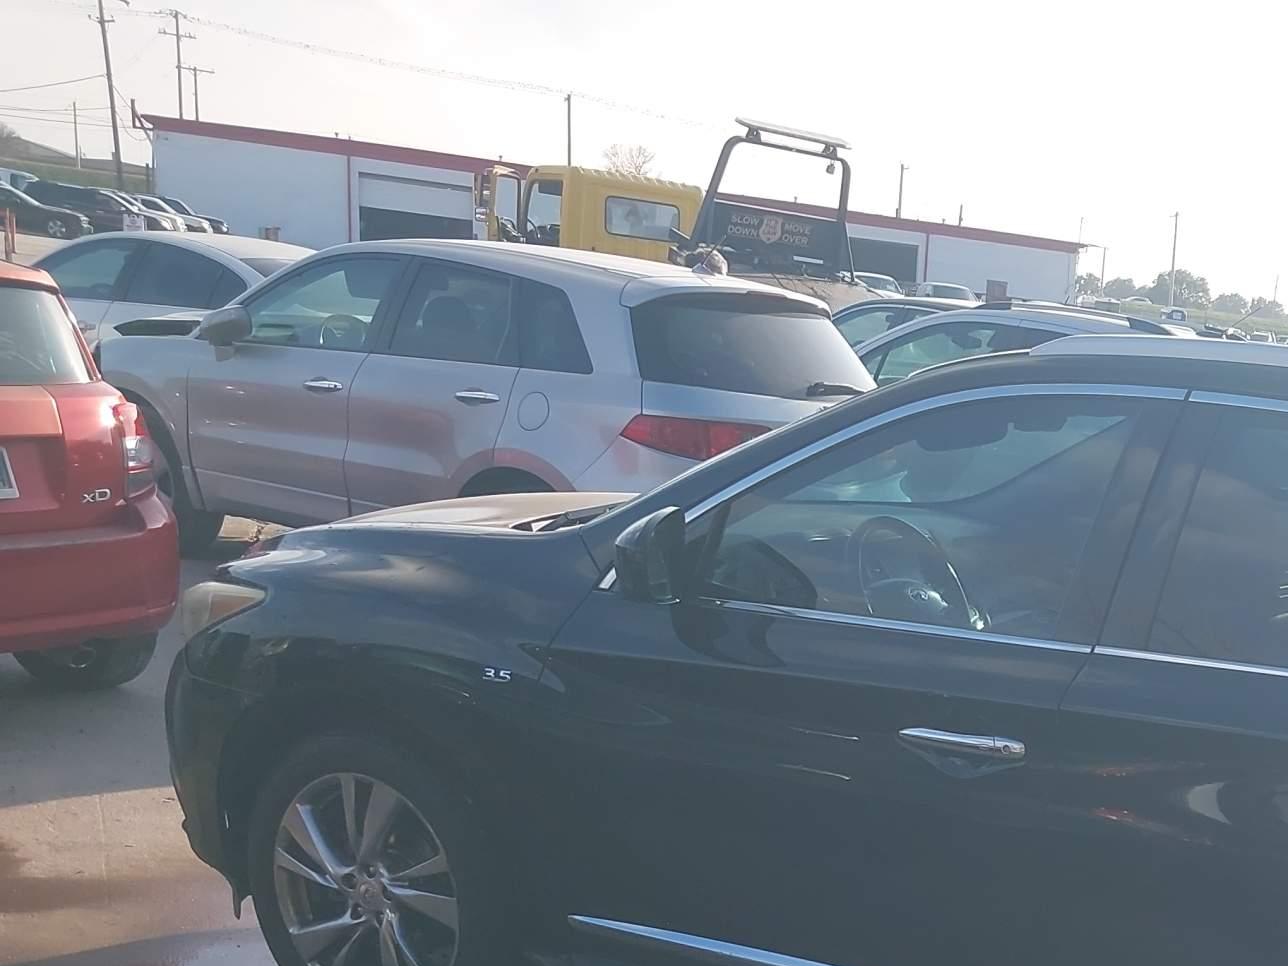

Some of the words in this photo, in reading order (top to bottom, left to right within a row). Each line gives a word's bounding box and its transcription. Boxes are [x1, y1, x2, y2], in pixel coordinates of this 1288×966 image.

[731, 214, 760, 226] SLOW
[727, 224, 758, 237] DOWN
[783, 222, 811, 235] MOVE
[782, 233, 809, 246] OVER
[82, 488, 112, 504] xD
